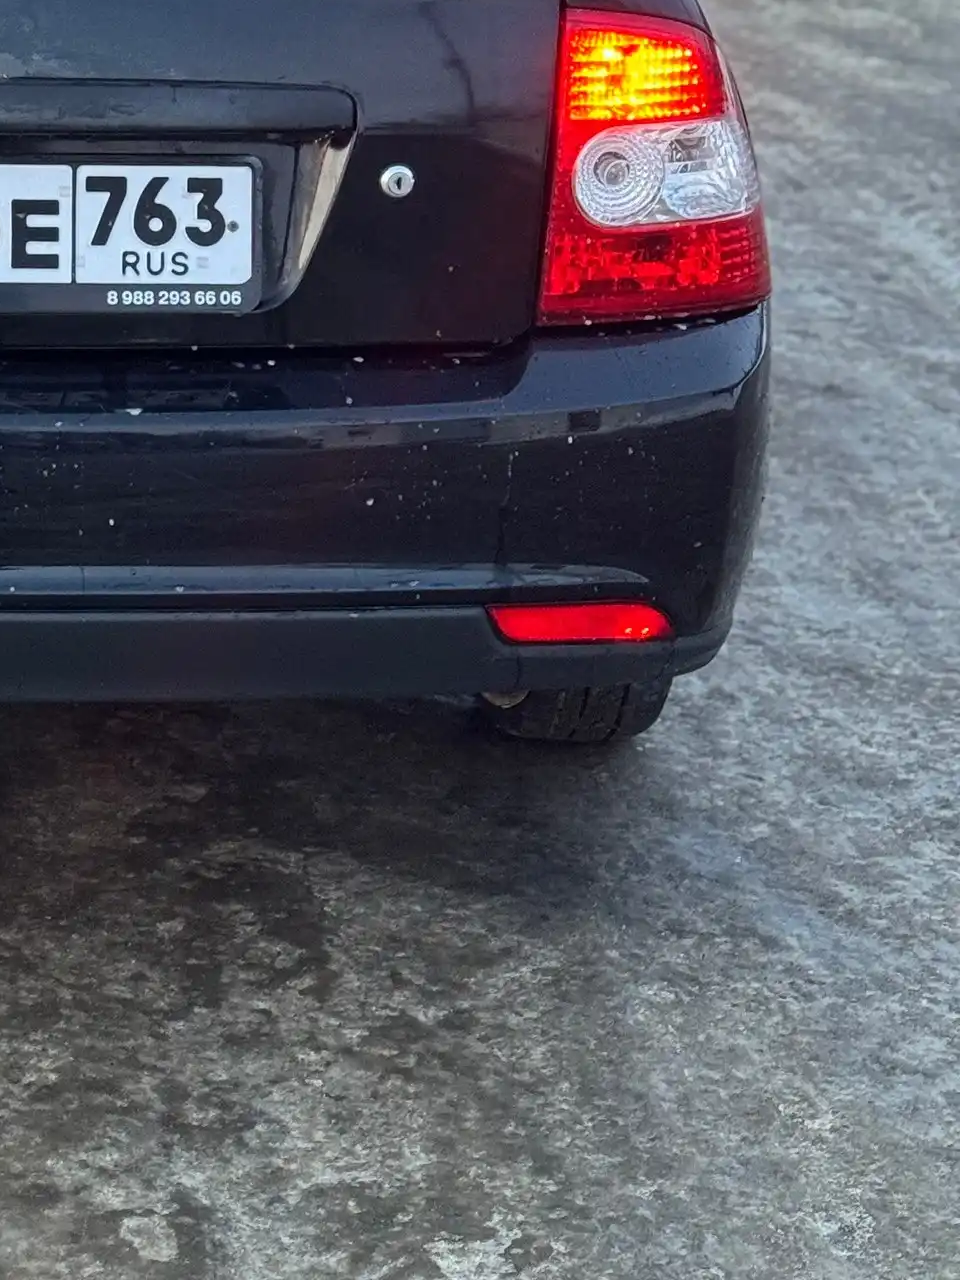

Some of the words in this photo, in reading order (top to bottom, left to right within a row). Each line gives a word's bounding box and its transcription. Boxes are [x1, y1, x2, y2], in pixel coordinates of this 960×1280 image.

[85, 175, 226, 247] 763
[121, 250, 189, 276] RUS
[106, 290, 119, 306] 8
[121, 290, 155, 306] 988
[158, 290, 191, 306] 293
[194, 290, 217, 306] 66
[219, 290, 242, 306] 06
